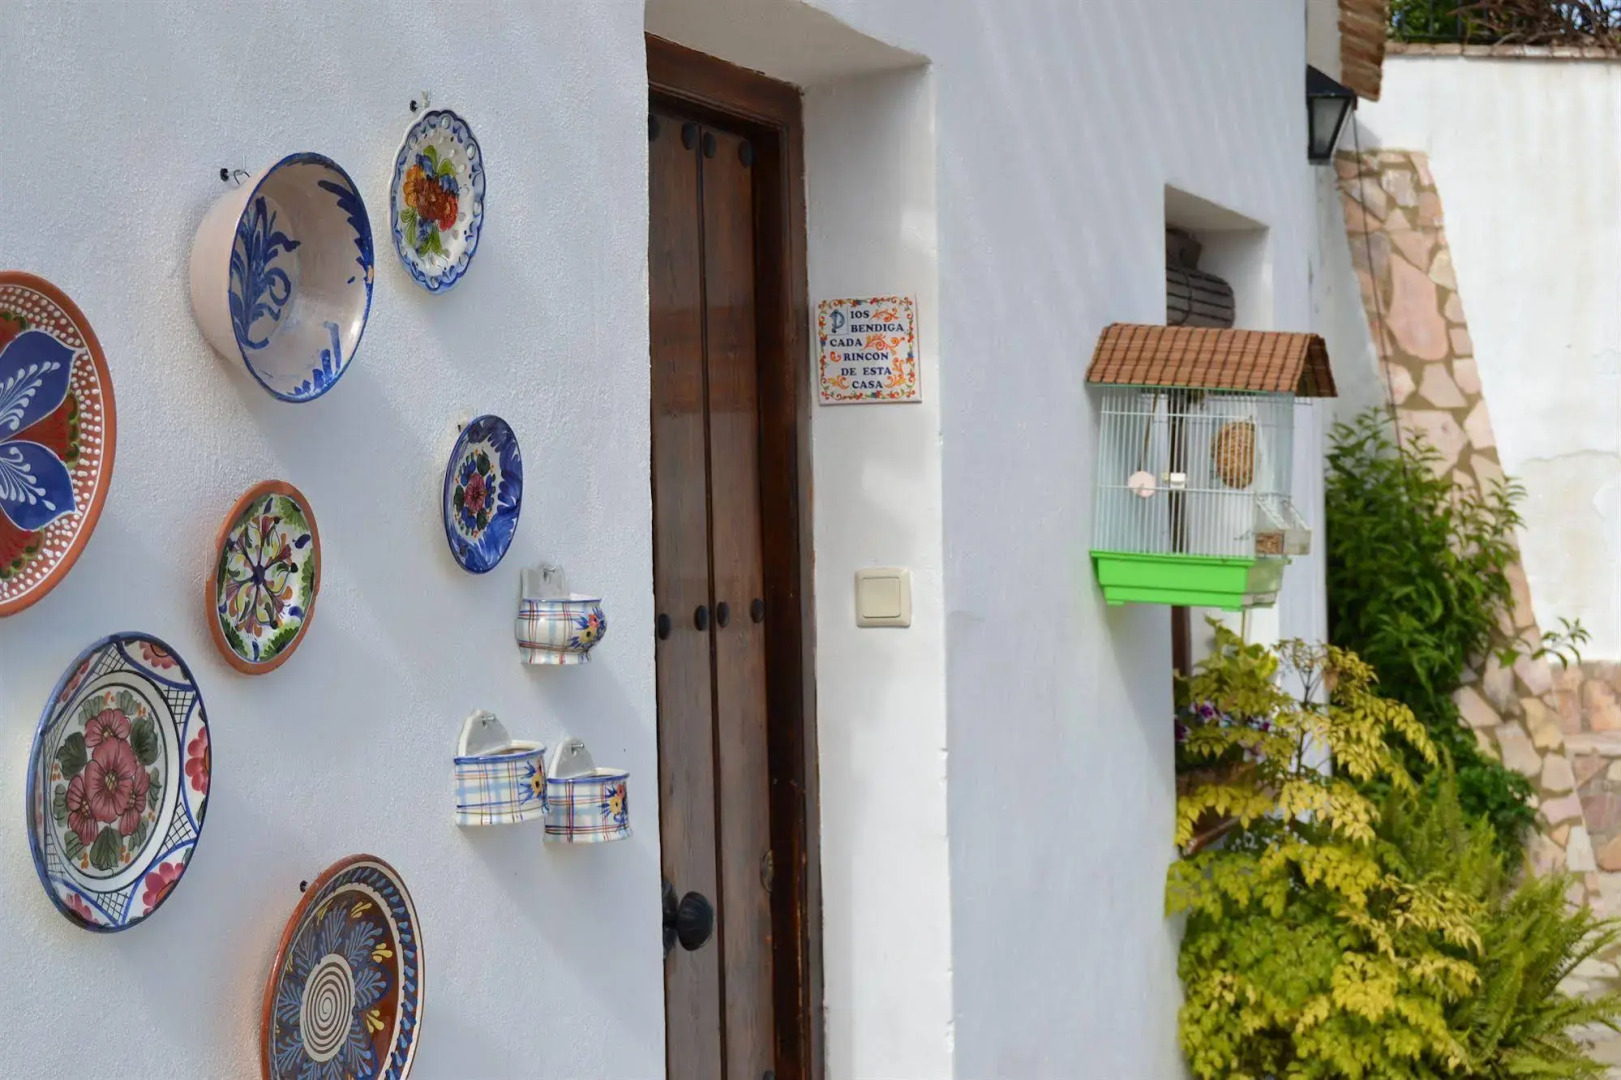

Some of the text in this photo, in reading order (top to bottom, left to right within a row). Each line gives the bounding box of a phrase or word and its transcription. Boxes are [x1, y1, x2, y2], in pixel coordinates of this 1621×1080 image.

[850, 323, 904, 333] BENDIGA
[829, 338, 862, 347] CADA
[841, 367, 892, 376] DE ESTA
[851, 380, 883, 389] CASA
